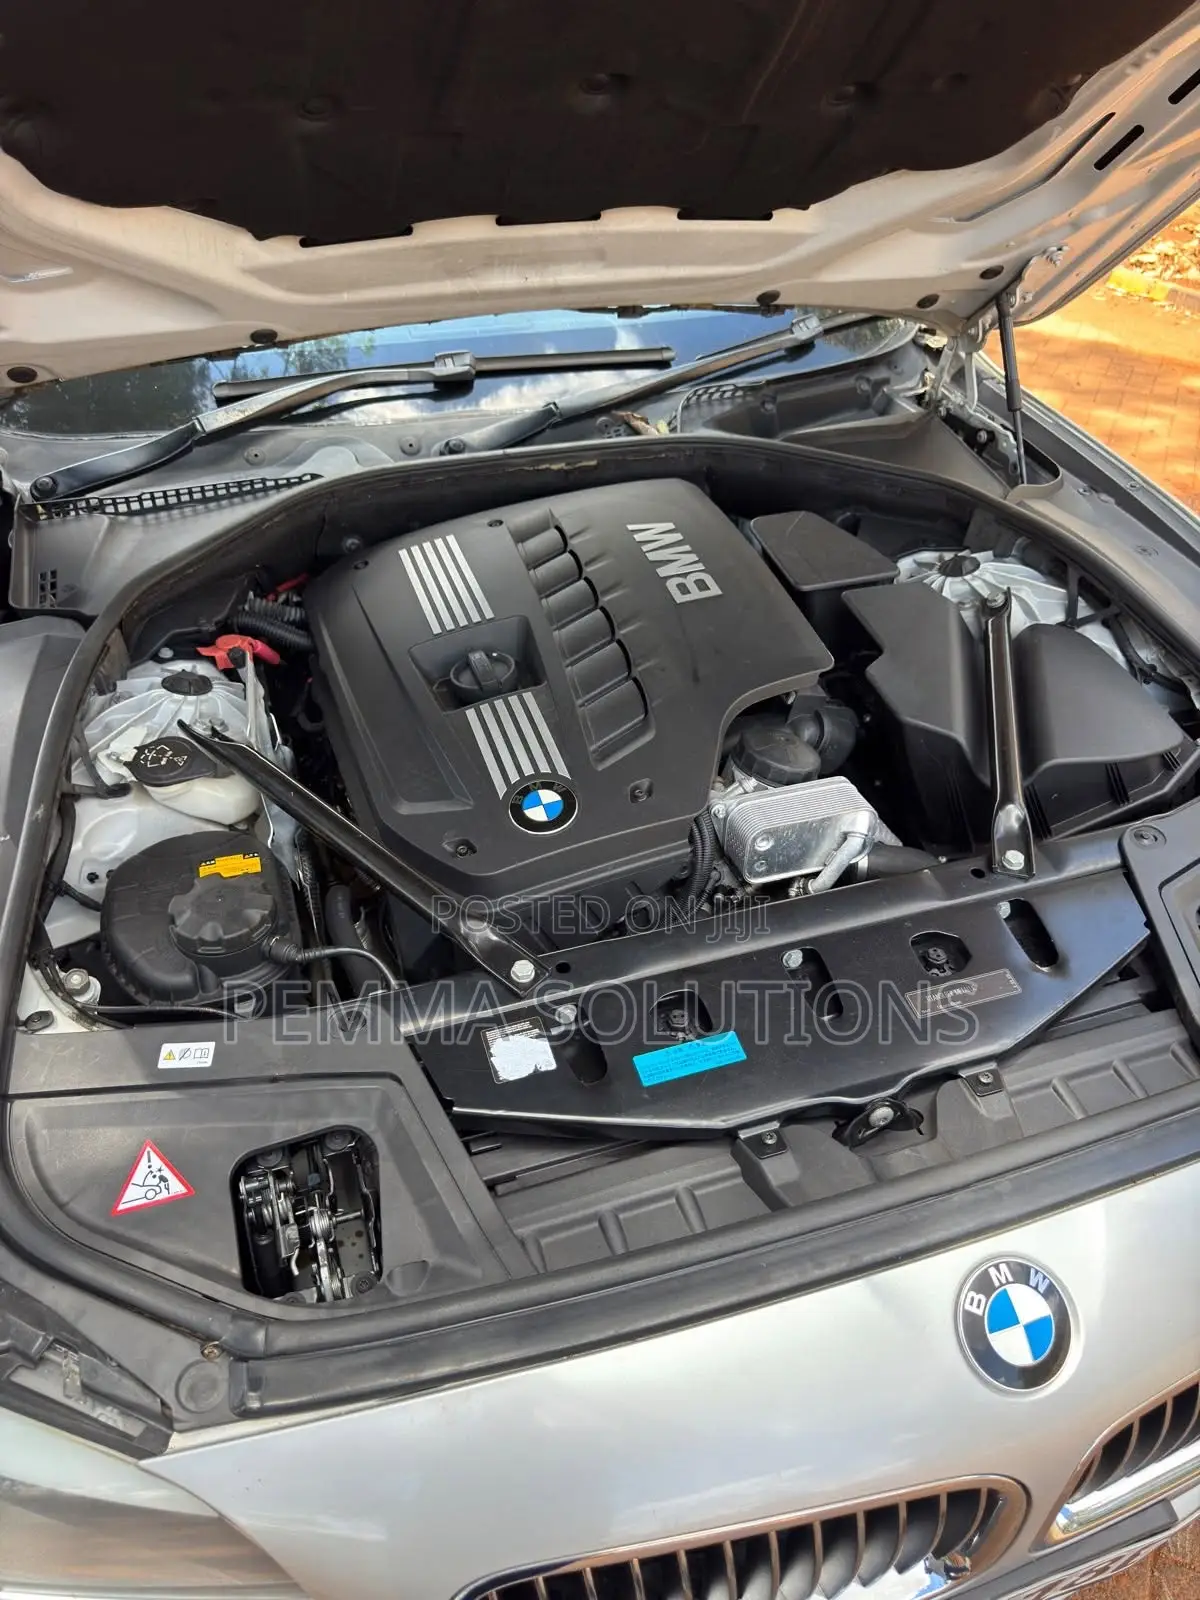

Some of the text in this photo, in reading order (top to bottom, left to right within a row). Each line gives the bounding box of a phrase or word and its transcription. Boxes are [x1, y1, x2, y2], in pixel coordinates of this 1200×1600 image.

[626, 522, 723, 604] BMW
[511, 781, 567, 805] BMW
[964, 1262, 1050, 1317] BMW
